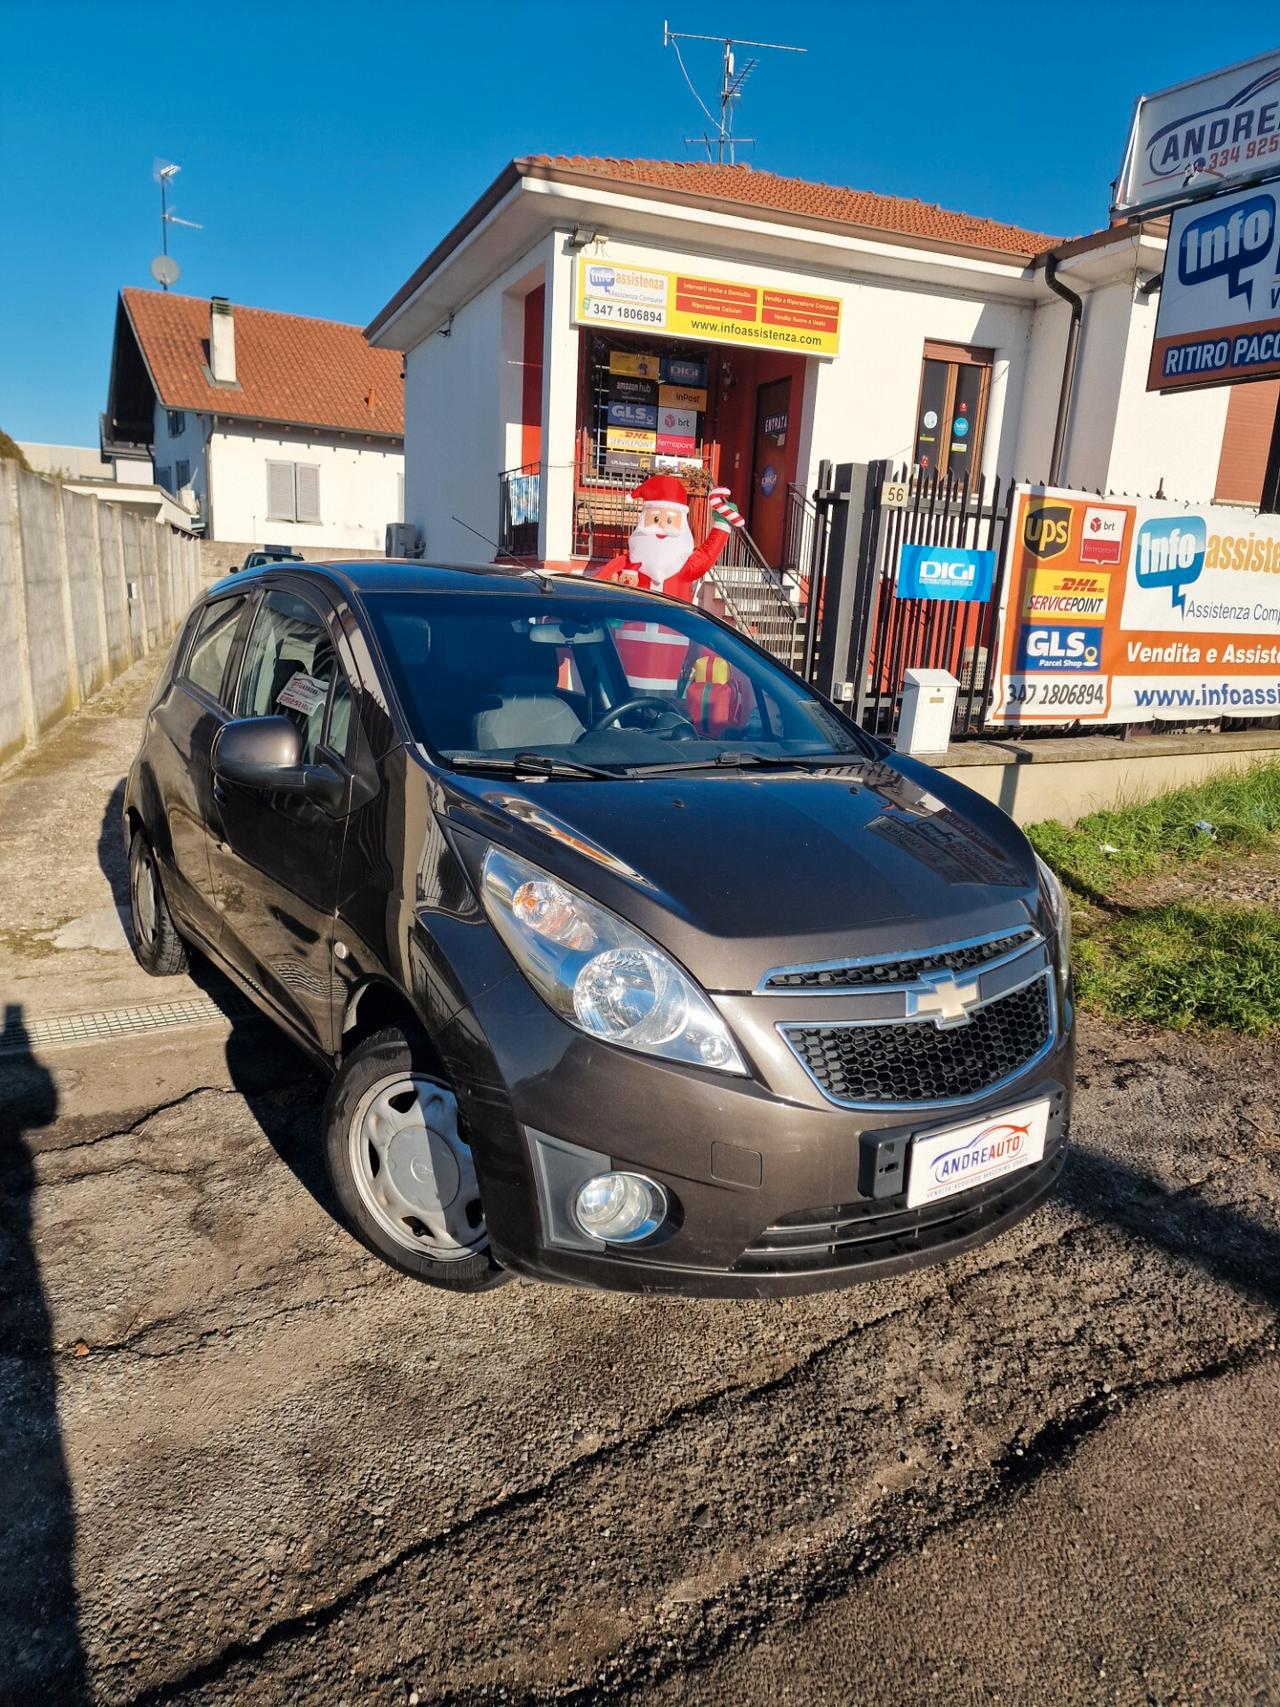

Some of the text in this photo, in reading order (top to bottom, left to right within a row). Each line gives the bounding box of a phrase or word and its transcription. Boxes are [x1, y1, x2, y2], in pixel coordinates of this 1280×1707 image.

[1160, 101, 1280, 165] ANDRE
[1209, 145, 1240, 170] 334
[1185, 208, 1270, 274] Info
[616, 272, 664, 290] assistenza
[593, 303, 662, 323] 347 1806894
[691, 319, 822, 346] www.infoassistenza.com
[1165, 341, 1229, 374] RITIRO
[616, 381, 651, 393] amazon hub
[611, 405, 647, 420] GLS
[678, 418, 690, 427] brt
[887, 487, 905, 503] 56
[1026, 518, 1068, 552] ups
[1103, 520, 1115, 531] brt
[1140, 528, 1196, 575] Info
[920, 560, 976, 581] DIGI
[1060, 578, 1098, 592] DHL
[1027, 595, 1104, 612] SERVICEPOINT
[1186, 600, 1280, 624] Assistenza Com
[1026, 630, 1086, 657] GLS
[1127, 642, 1201, 663] Vendita
[1206, 647, 1218, 663] e
[1039, 659, 1083, 668] Parcel Shop
[1007, 683, 1104, 705] 347 1806894
[941, 1135, 1021, 1177] ANDREAUTO
